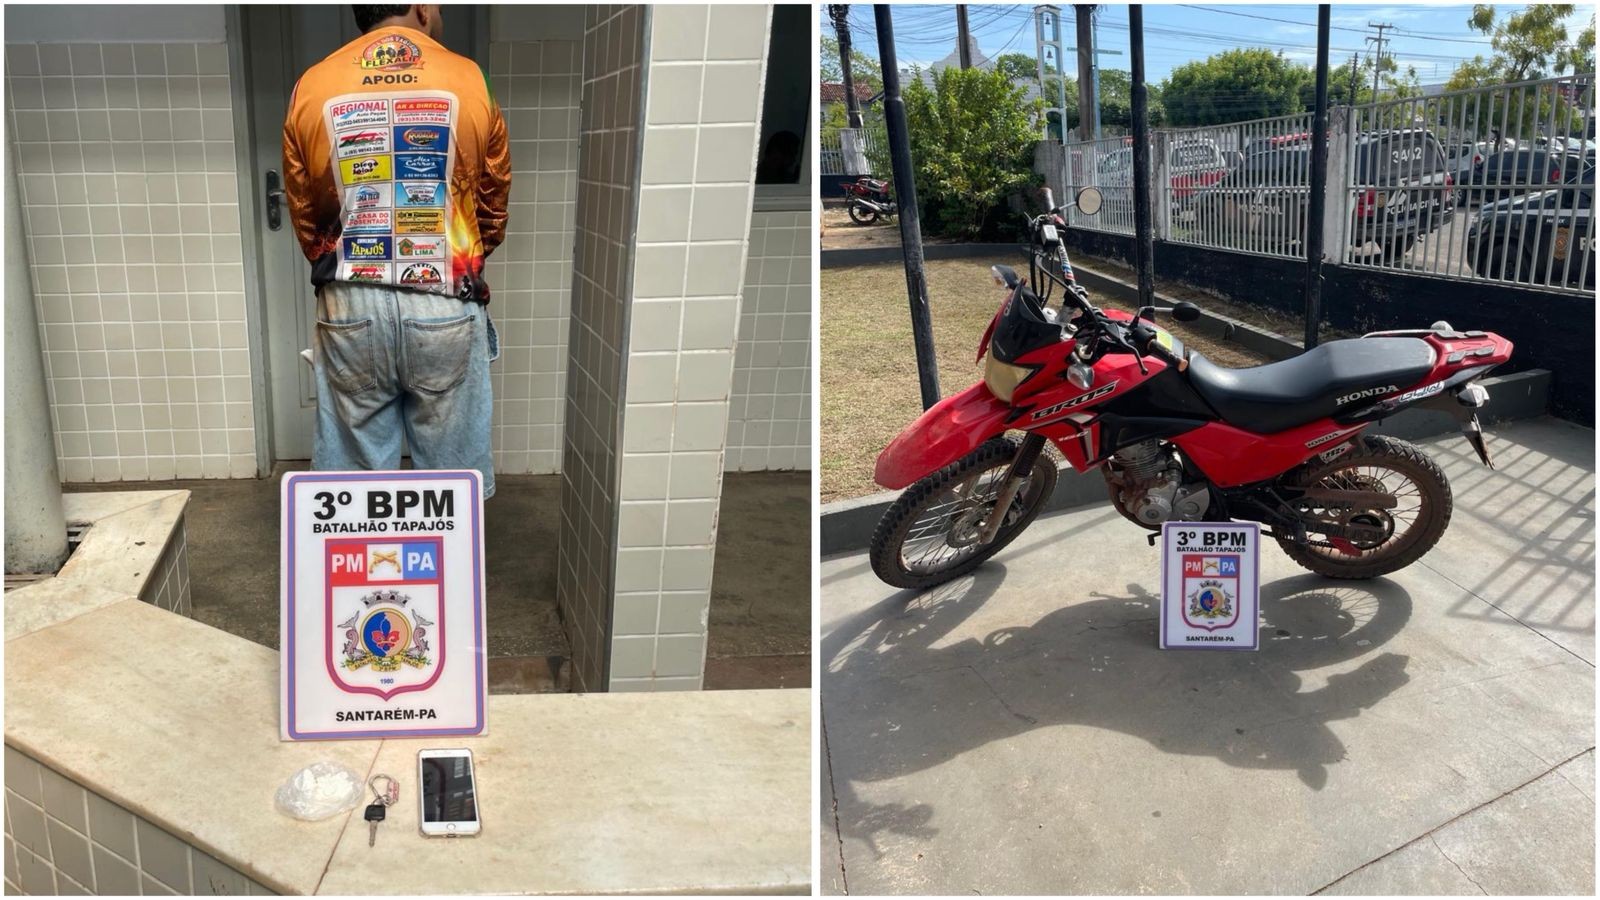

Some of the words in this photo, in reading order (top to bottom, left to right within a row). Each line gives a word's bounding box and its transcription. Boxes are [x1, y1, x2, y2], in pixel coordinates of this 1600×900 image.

[362, 74, 418, 85] APOIO:
[332, 101, 387, 117] REGIONAL
[1031, 380, 1119, 420] BROS
[1336, 384, 1400, 406] HONDA
[1307, 432, 1339, 447] HONDA
[313, 491, 352, 520] 3º
[367, 489, 454, 519] BPM
[313, 520, 388, 533] BATALHÃO
[392, 519, 454, 532] TAPAJÓS
[1177, 531, 1196, 546] 3º
[1203, 531, 1246, 546] BPM
[331, 553, 364, 573] PM
[407, 551, 435, 571] PA
[1185, 561, 1201, 572] PM
[1222, 561, 1236, 572] PA
[336, 707, 437, 722] SANTARÉM-PA
